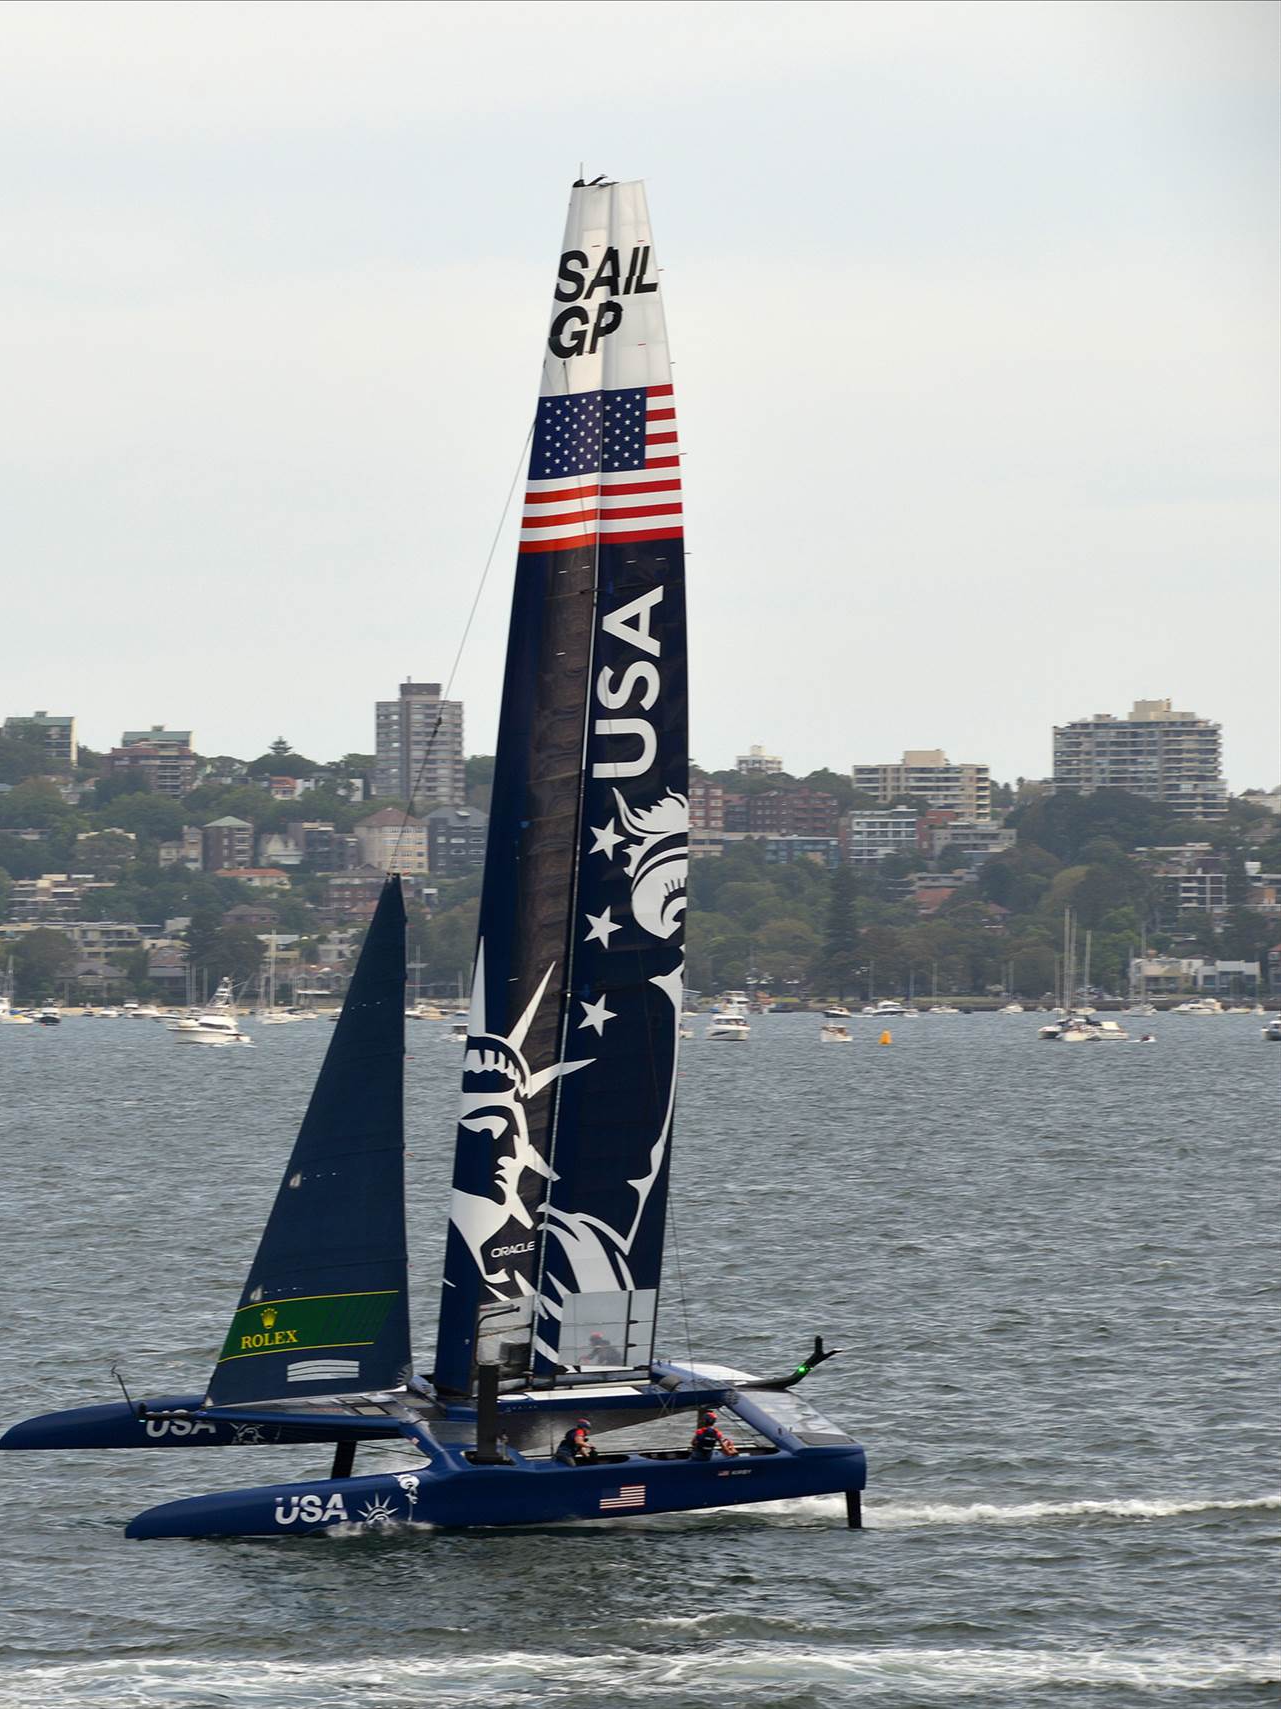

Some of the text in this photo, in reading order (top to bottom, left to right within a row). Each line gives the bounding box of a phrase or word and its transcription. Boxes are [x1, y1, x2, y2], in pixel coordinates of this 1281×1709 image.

[554, 246, 658, 302] SAIL
[548, 300, 624, 359] GP
[592, 585, 664, 778] USA
[491, 1241, 535, 1258] ORACLE
[241, 1330, 298, 1349] ROLEX
[275, 1493, 349, 1525] USA
